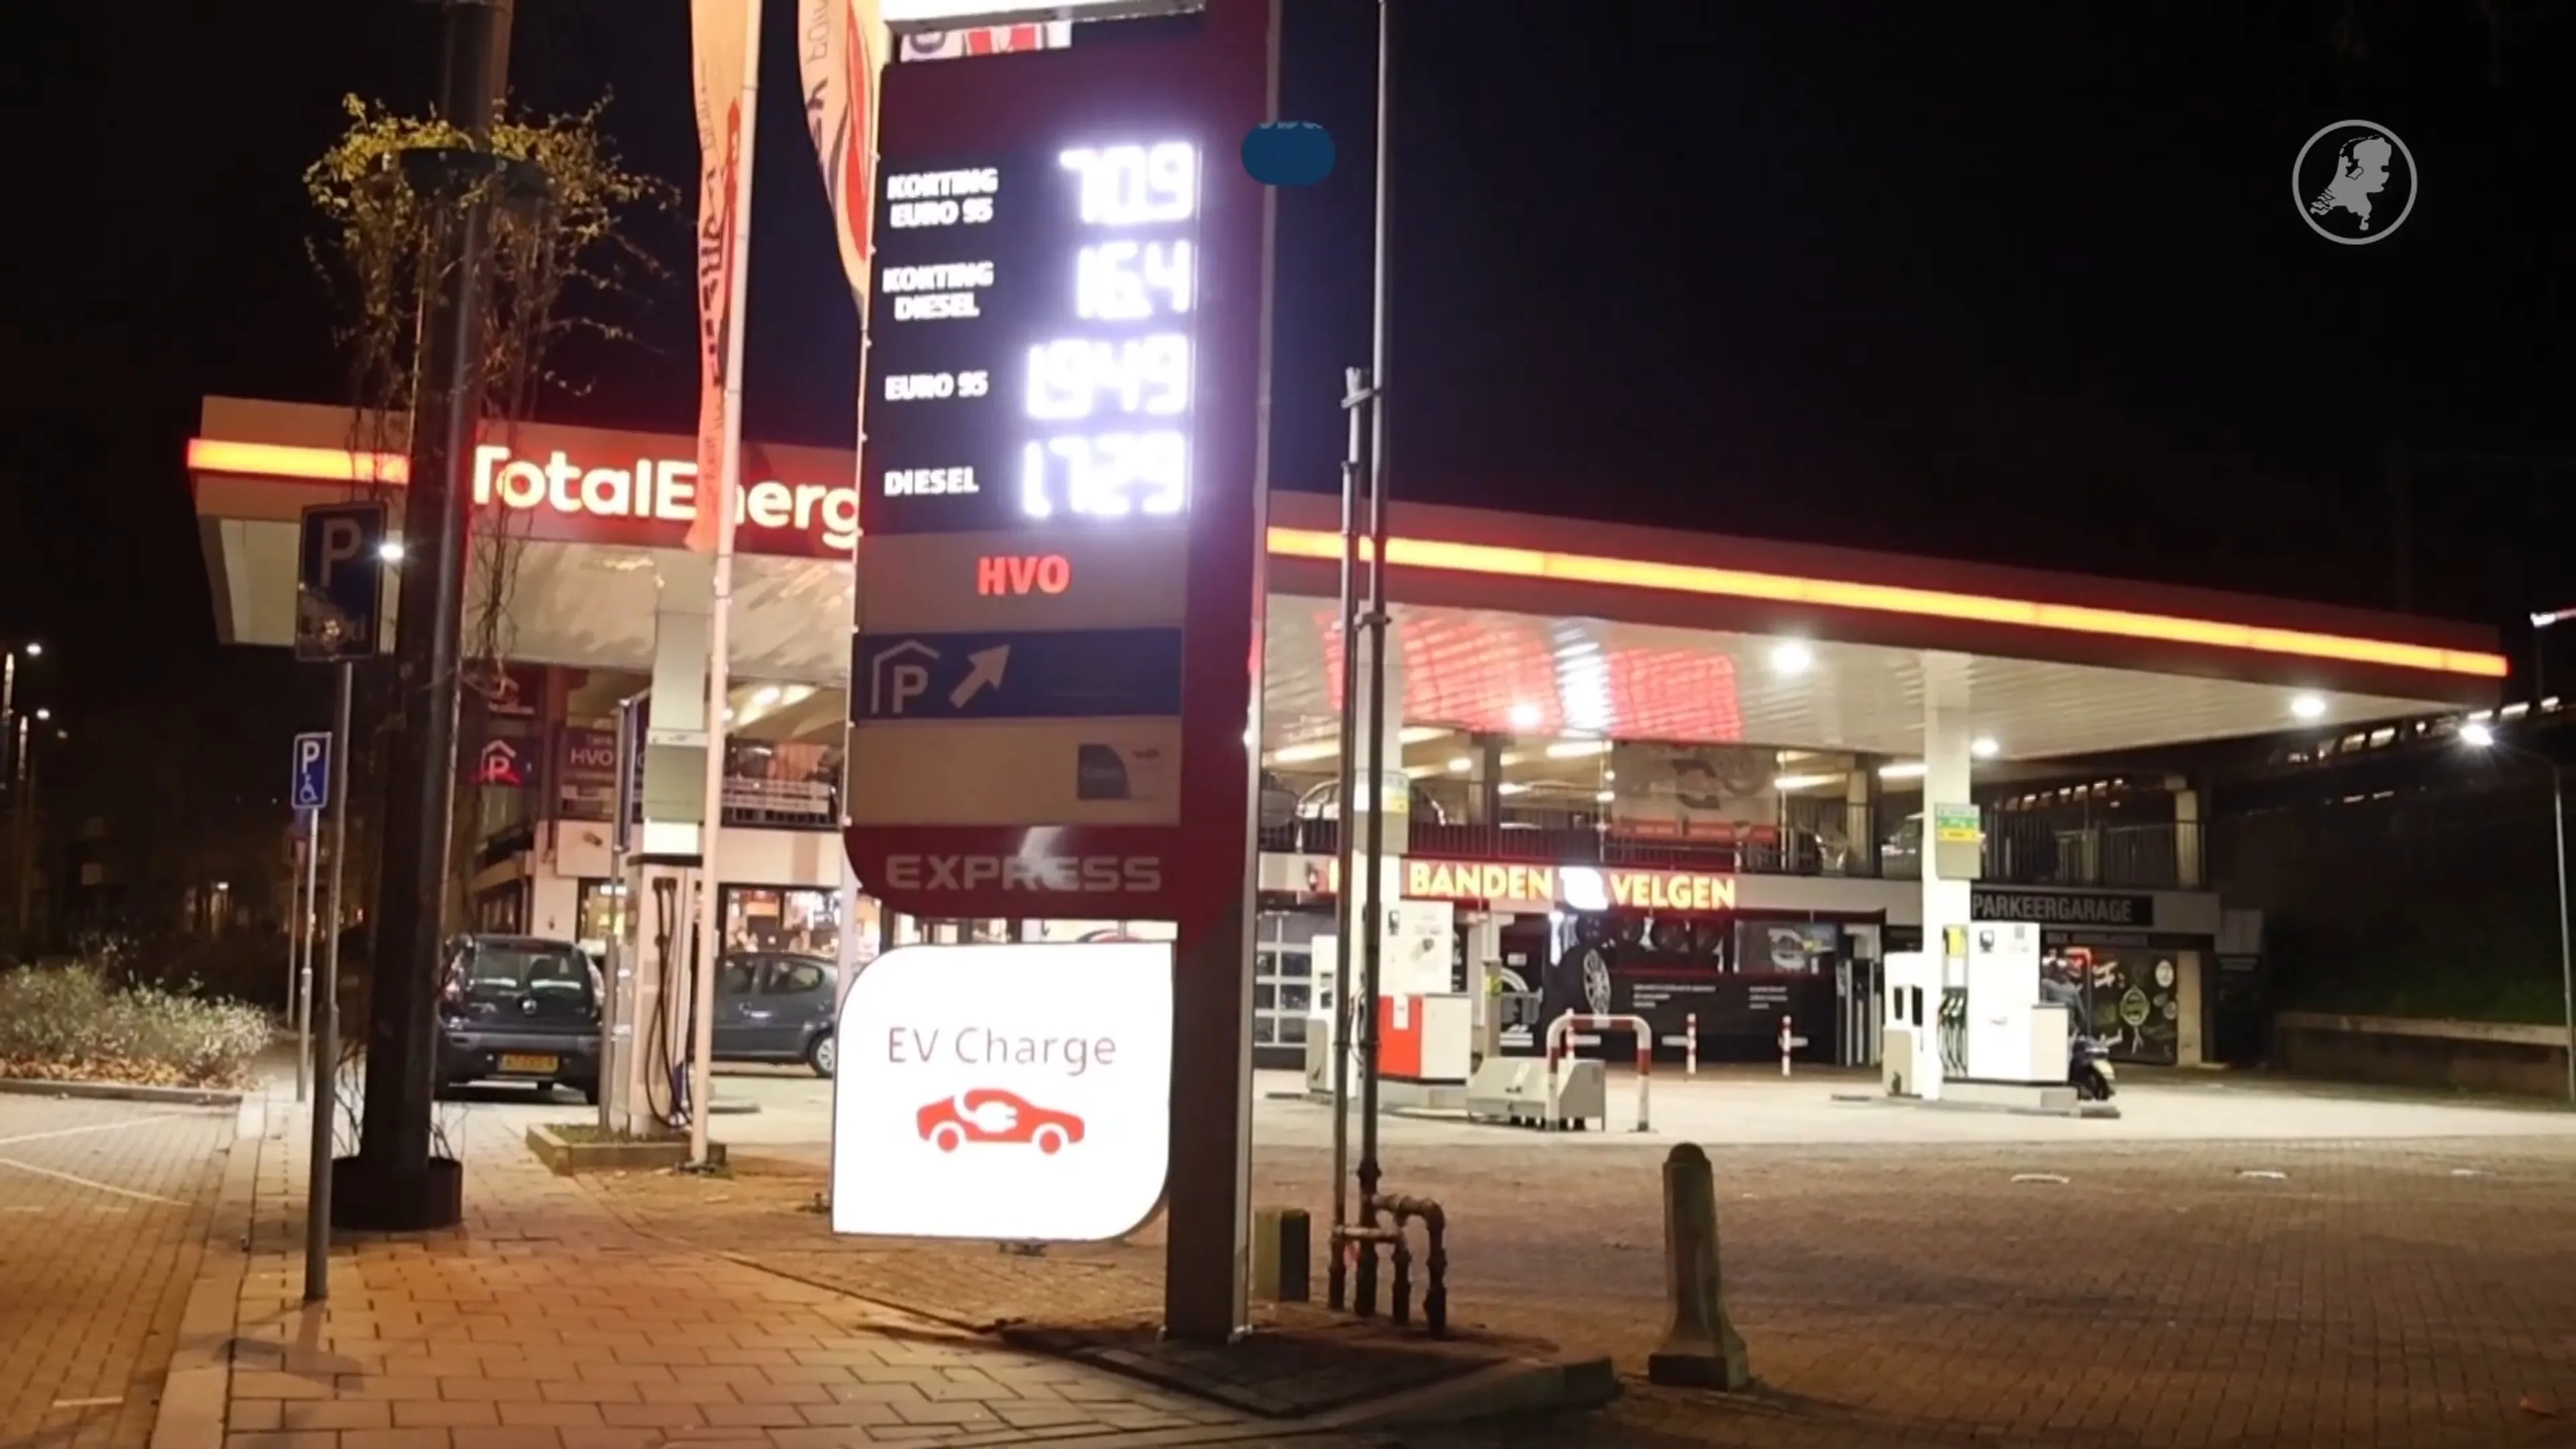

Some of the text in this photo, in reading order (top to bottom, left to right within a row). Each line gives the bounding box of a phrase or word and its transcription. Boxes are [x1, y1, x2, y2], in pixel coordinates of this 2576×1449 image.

[887, 168, 998, 200] KORTING
[890, 197, 994, 227] EURO 95
[883, 261, 994, 293] KORTING
[894, 292, 980, 321] DIESEL
[885, 371, 988, 400] EURO 95
[884, 467, 979, 495] DIESEL
[473, 445, 858, 550] TotalEerg
[320, 519, 362, 587] P
[977, 555, 1069, 595] HVO
[303, 742, 319, 772] P
[571, 749, 614, 766] HVO
[885, 855, 1161, 892] EXPRESS
[1410, 861, 1553, 900] BANDEN
[1611, 872, 1735, 910] VELGEN
[1972, 894, 2133, 922] PARKEERGARAGE
[889, 1027, 1116, 1076] EV Charge
